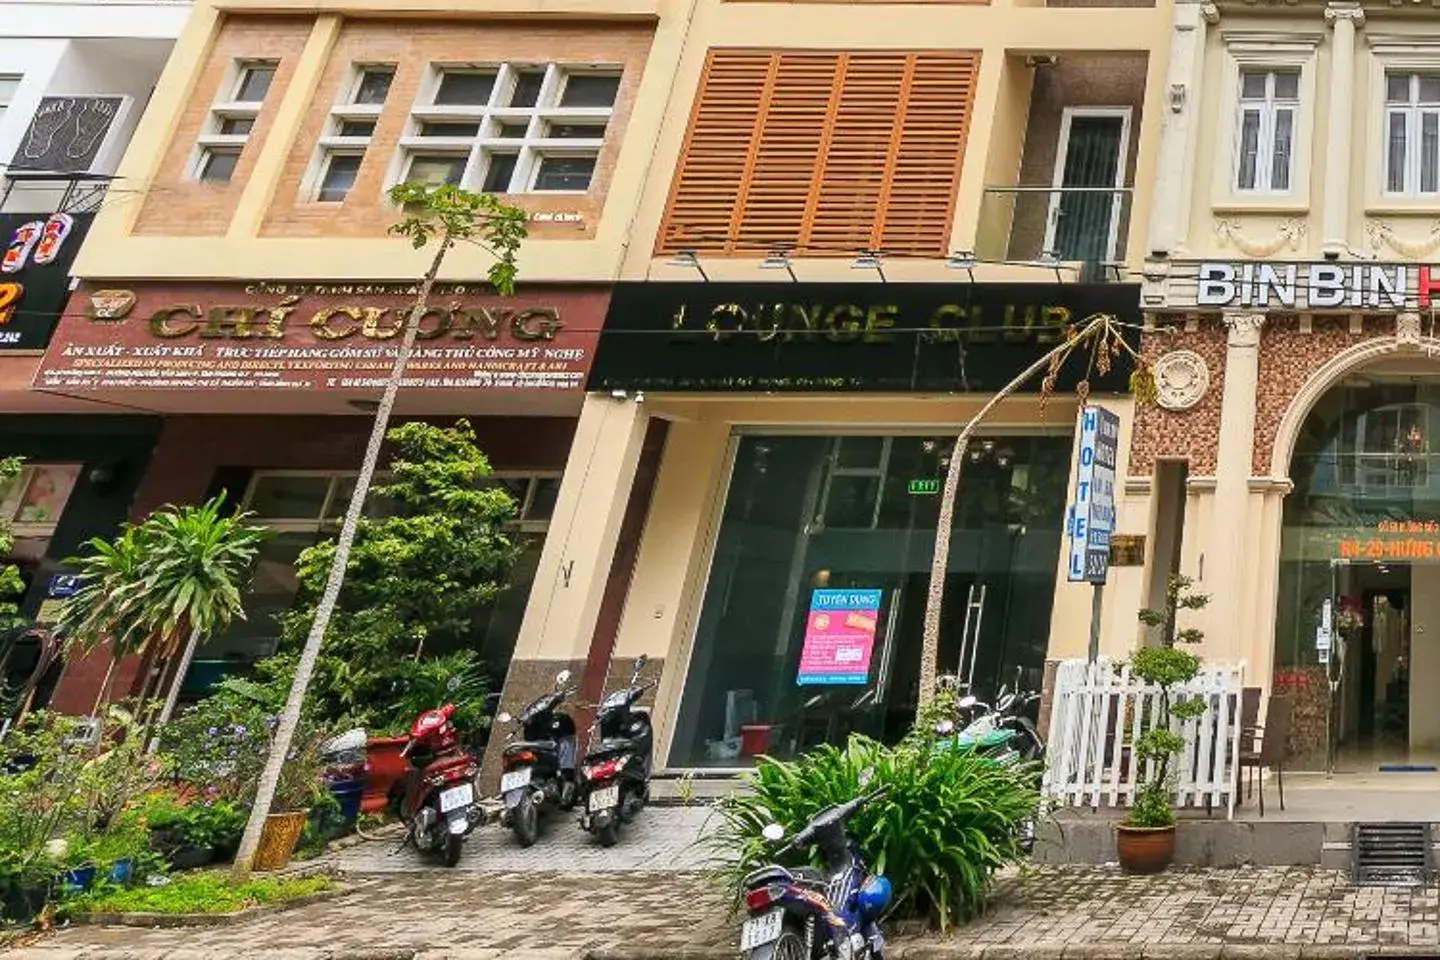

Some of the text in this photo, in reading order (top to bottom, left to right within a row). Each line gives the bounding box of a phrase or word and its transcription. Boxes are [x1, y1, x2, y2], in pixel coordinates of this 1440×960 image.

[1198, 263, 1297, 307] BIN
[1308, 264, 1407, 307] BIN
[150, 294, 300, 339] CHÍ
[1071, 411, 1096, 577] HOTEL
